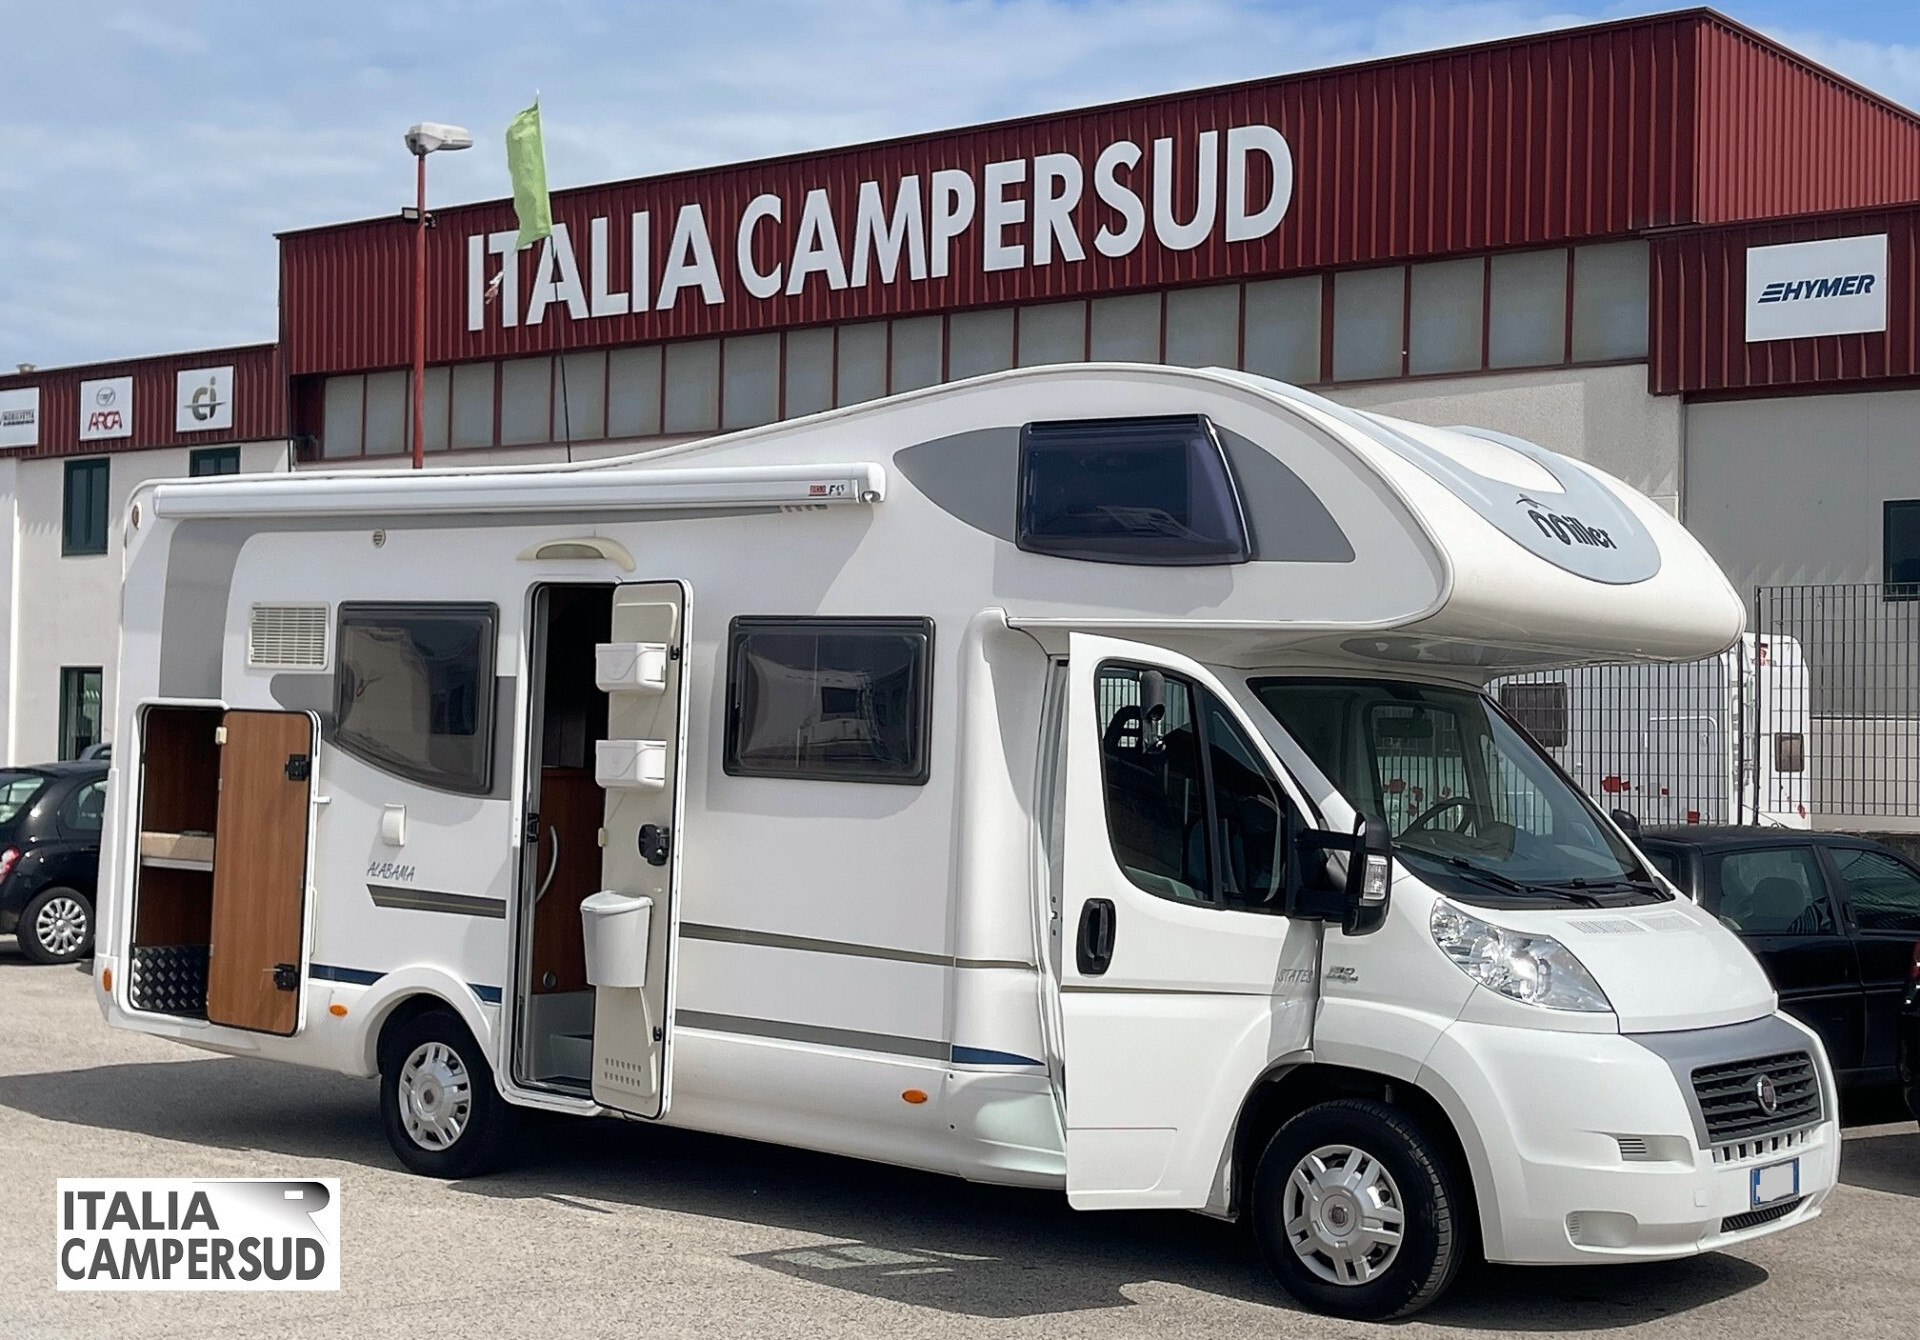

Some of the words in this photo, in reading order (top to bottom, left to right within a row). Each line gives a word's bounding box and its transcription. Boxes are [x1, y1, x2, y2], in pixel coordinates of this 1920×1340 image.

[468, 203, 725, 331] ITALIA
[737, 125, 1294, 299] CAMPERSUD
[1781, 274, 1876, 302] HYMER
[88, 411, 123, 431] ARCA
[366, 861, 415, 882] ALABAMA
[1277, 968, 1313, 984] STATES
